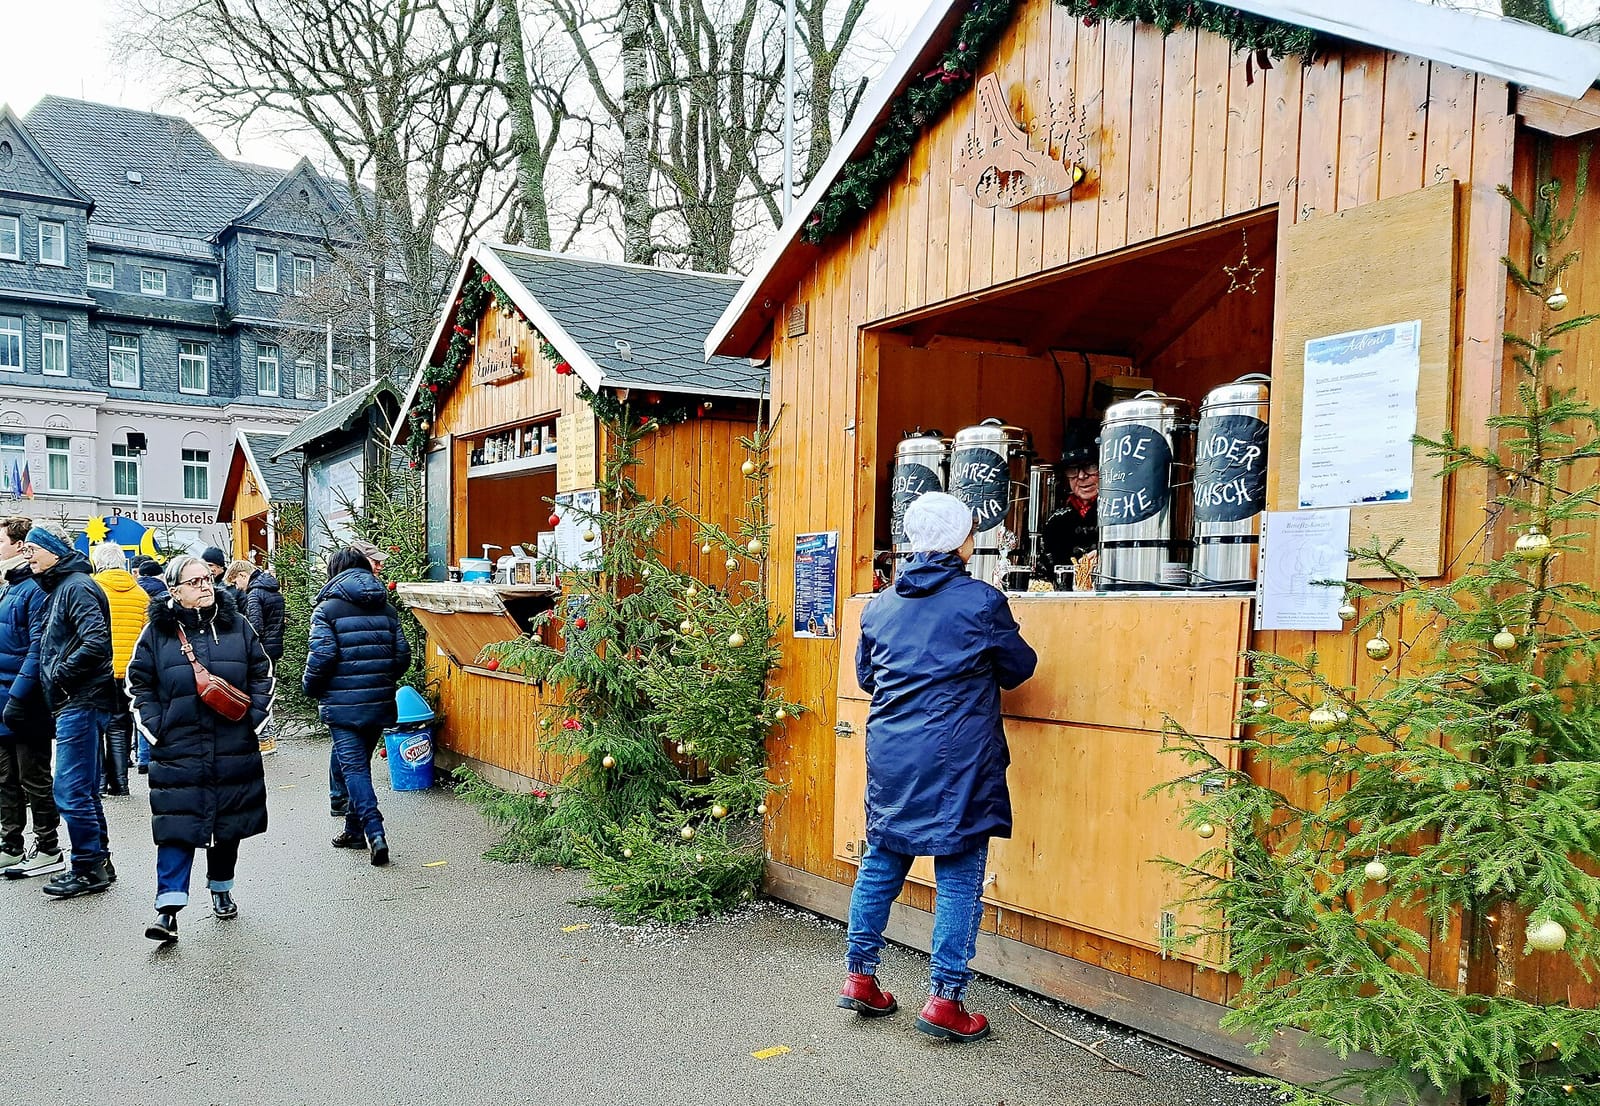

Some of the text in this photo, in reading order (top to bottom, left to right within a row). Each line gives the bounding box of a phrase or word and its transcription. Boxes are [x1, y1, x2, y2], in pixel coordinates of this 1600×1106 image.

[1340, 332, 1386, 355] Advent
[1195, 433, 1261, 471] INDER
[971, 499, 1003, 526] NA
